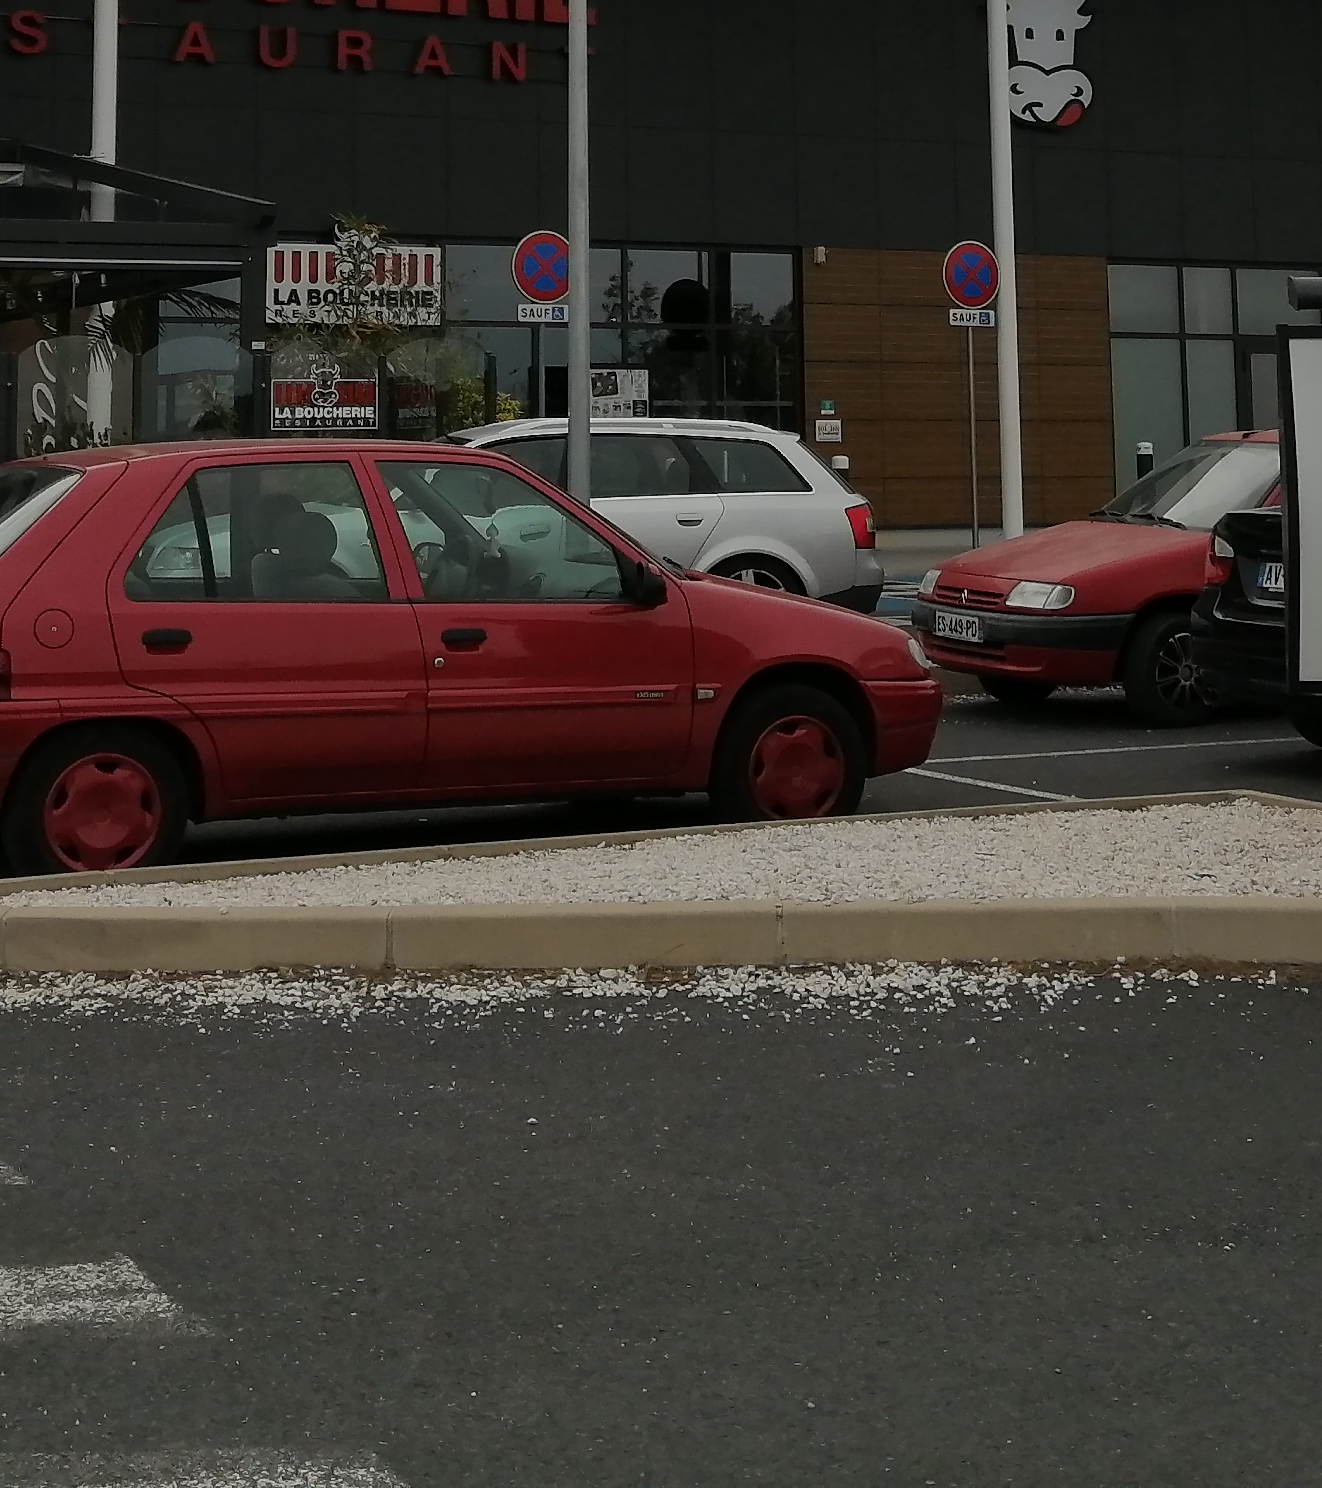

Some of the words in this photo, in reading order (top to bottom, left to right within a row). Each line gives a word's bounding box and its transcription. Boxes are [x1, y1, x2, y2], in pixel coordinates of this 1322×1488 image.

[273, 288, 302, 306] LA
[521, 308, 551, 318] SAUF
[952, 313, 977, 323] SAUF
[275, 407, 292, 418] LA
[295, 407, 374, 418] BOUCHERIE
